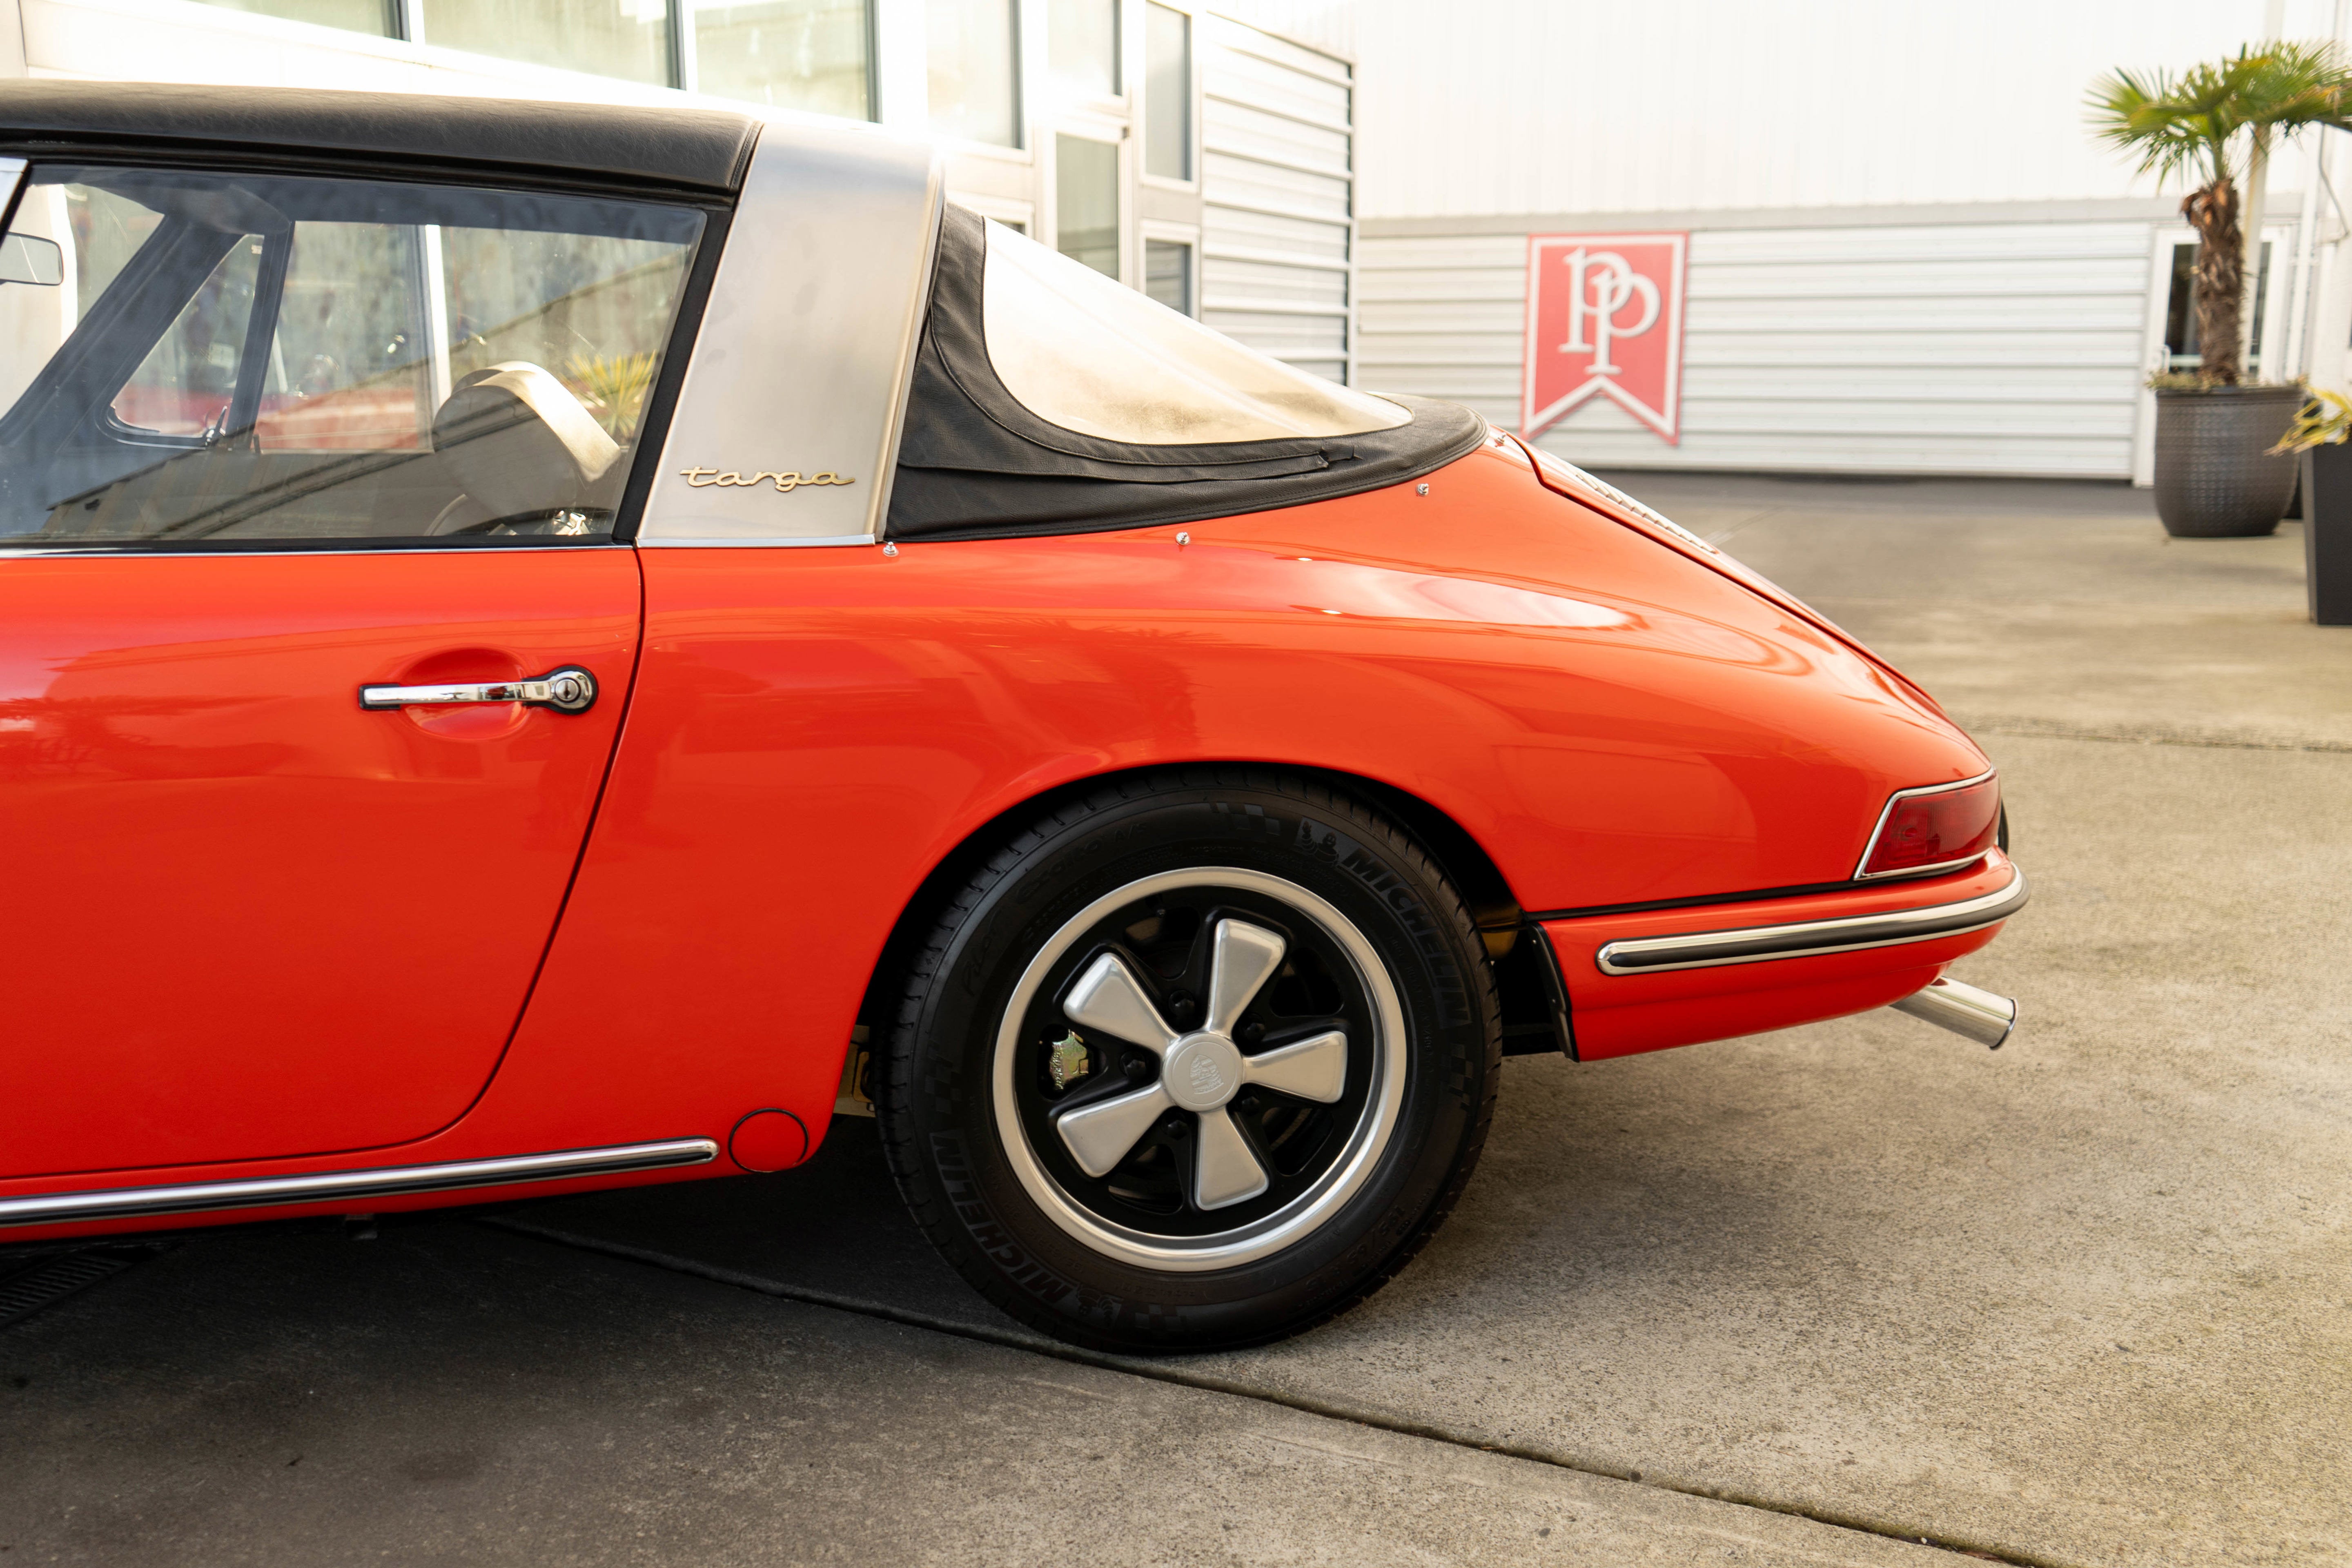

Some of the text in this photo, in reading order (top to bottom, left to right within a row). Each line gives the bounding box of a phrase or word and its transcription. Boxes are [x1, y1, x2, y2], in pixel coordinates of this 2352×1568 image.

[679, 466, 855, 492] targa
[1341, 847, 1468, 1021] MICHELIN
[932, 1136, 1074, 1305] MICHELIN
